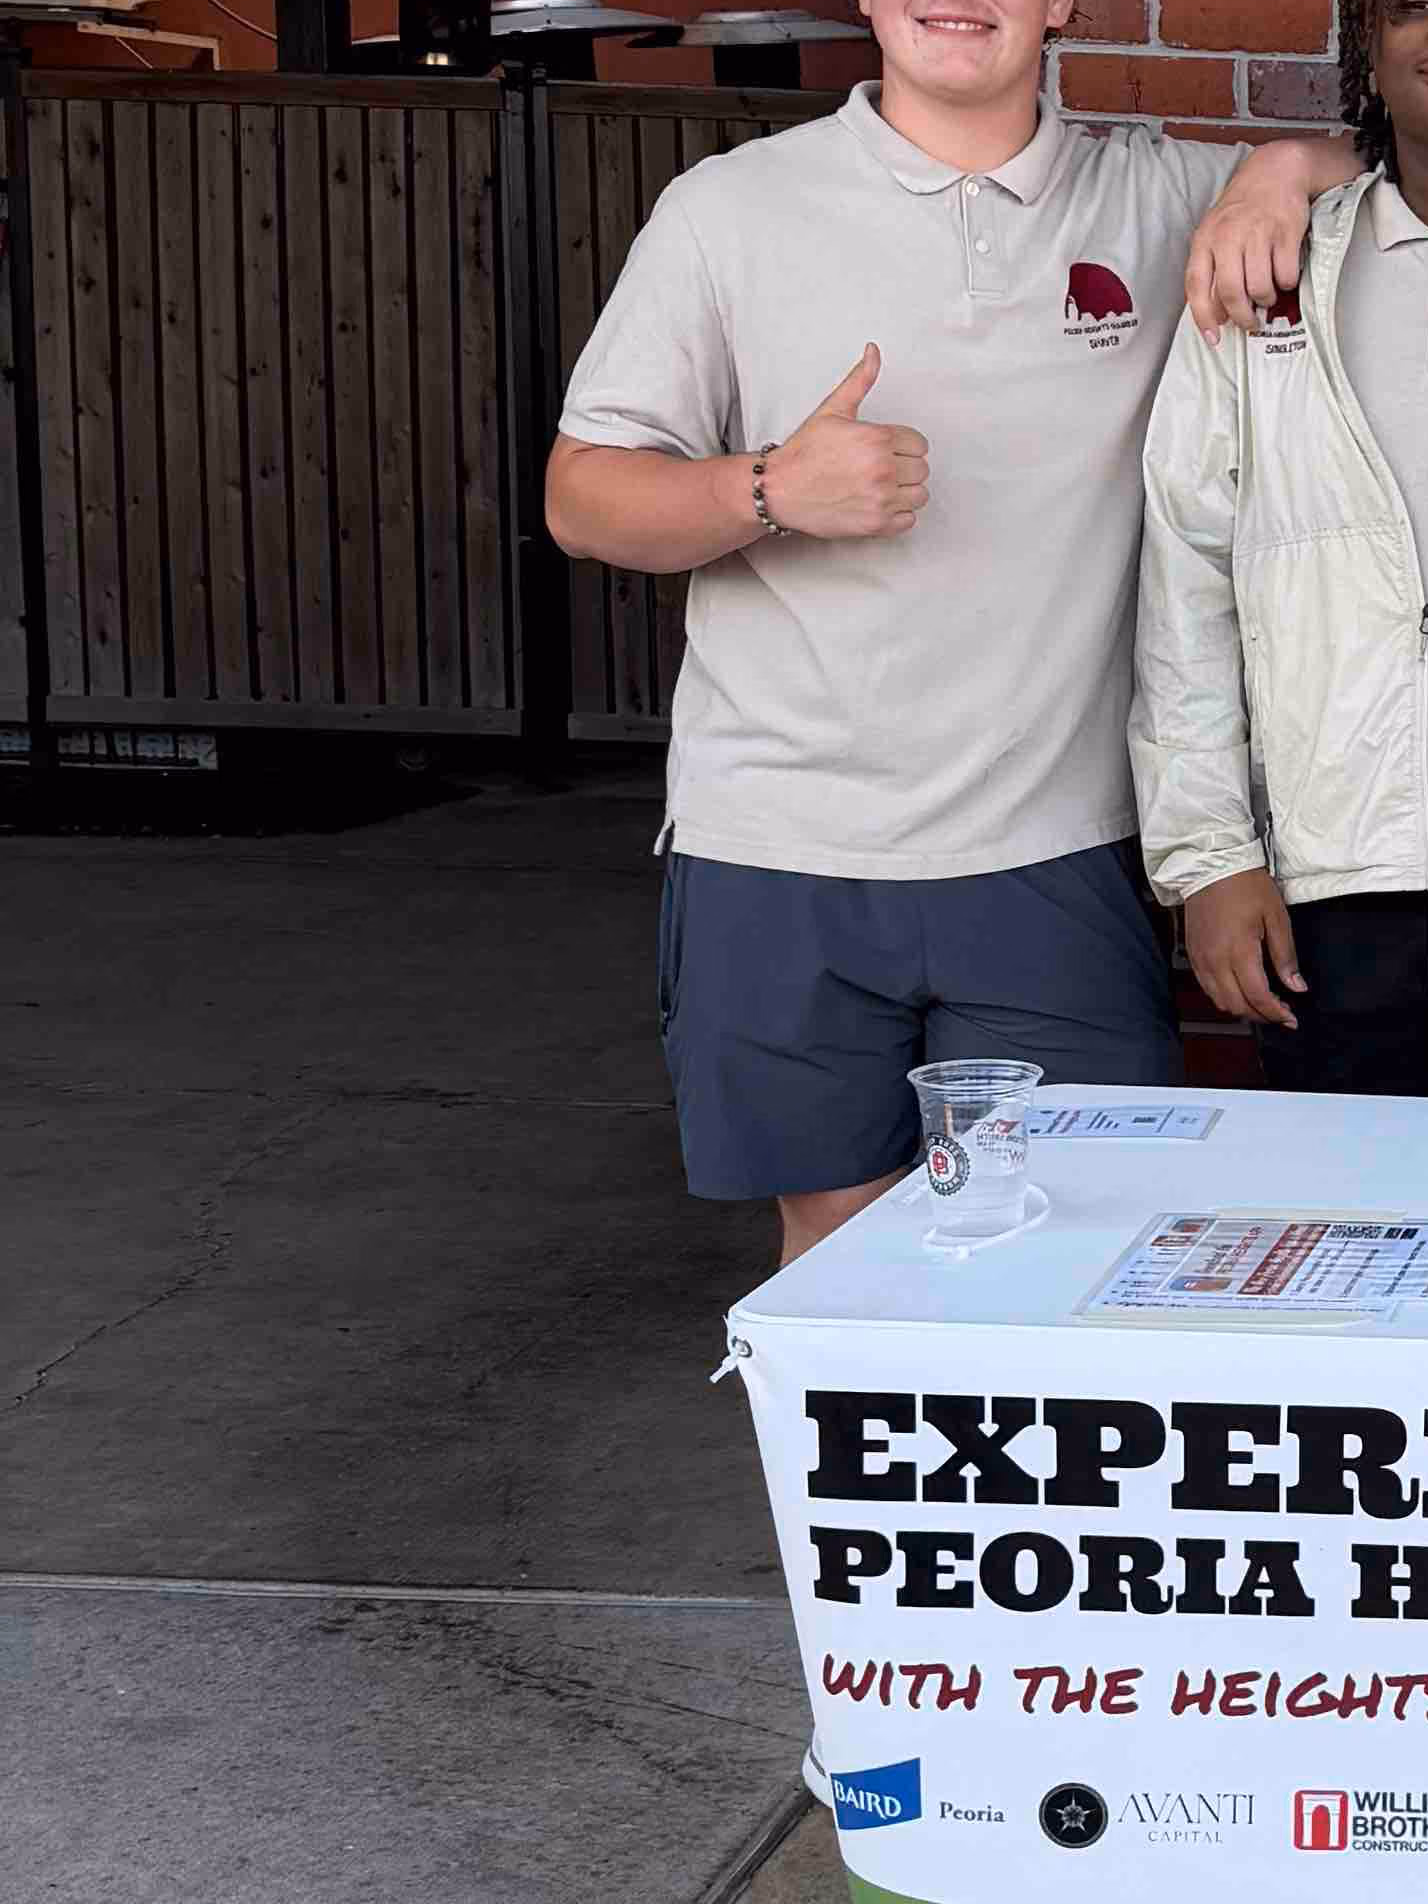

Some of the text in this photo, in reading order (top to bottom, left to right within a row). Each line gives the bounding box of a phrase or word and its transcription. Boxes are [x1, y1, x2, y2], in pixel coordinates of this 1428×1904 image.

[809, 1525, 1316, 1618] PEORIA
[822, 1652, 982, 1712] WITH
[1013, 1664, 1144, 1715] THE
[833, 1778, 902, 1821] BAIRD
[939, 1800, 1006, 1824] Peoria
[1117, 1792, 1257, 1826] AVANTI
[1147, 1830, 1224, 1845] CAPITAL
